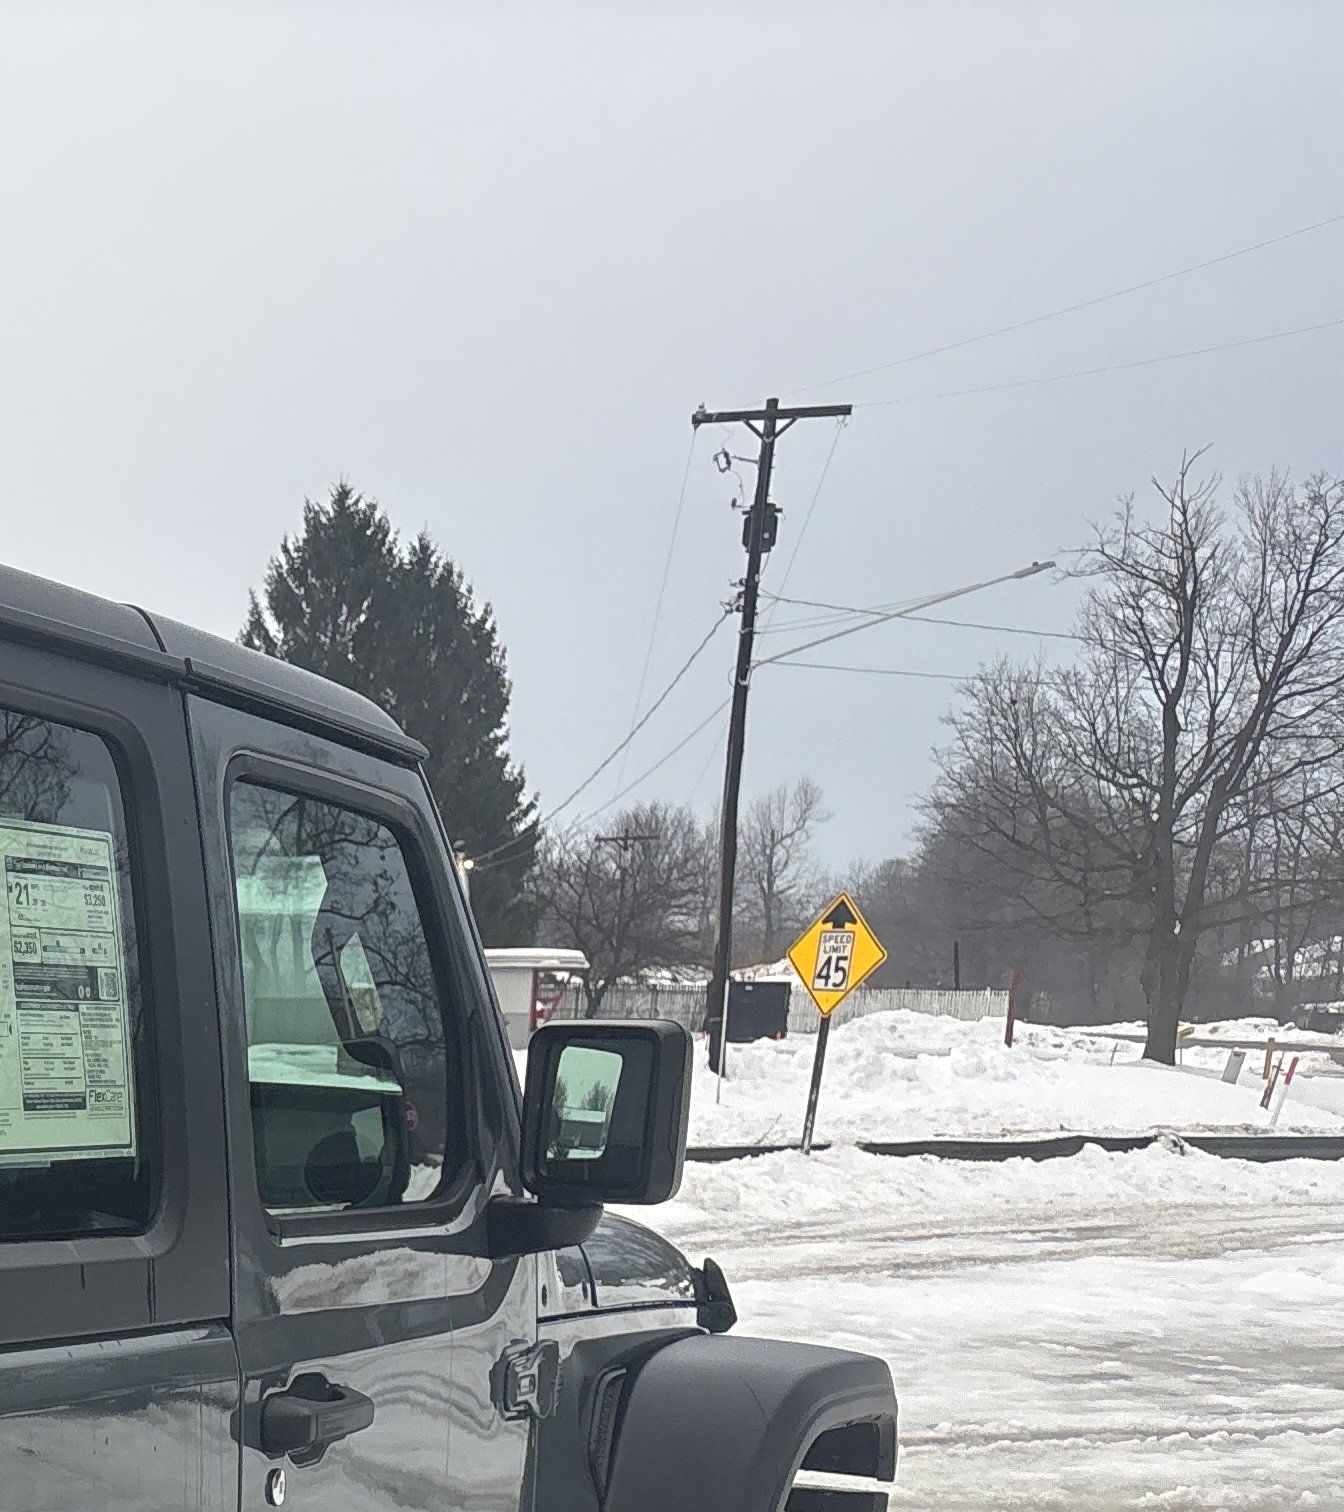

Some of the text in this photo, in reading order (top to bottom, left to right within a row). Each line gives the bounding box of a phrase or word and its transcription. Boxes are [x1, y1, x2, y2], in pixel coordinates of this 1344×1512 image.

[14, 881, 30, 907] 21
[823, 934, 852, 944] SPEED
[823, 945, 848, 955] LIMIT
[816, 955, 849, 988] 45
